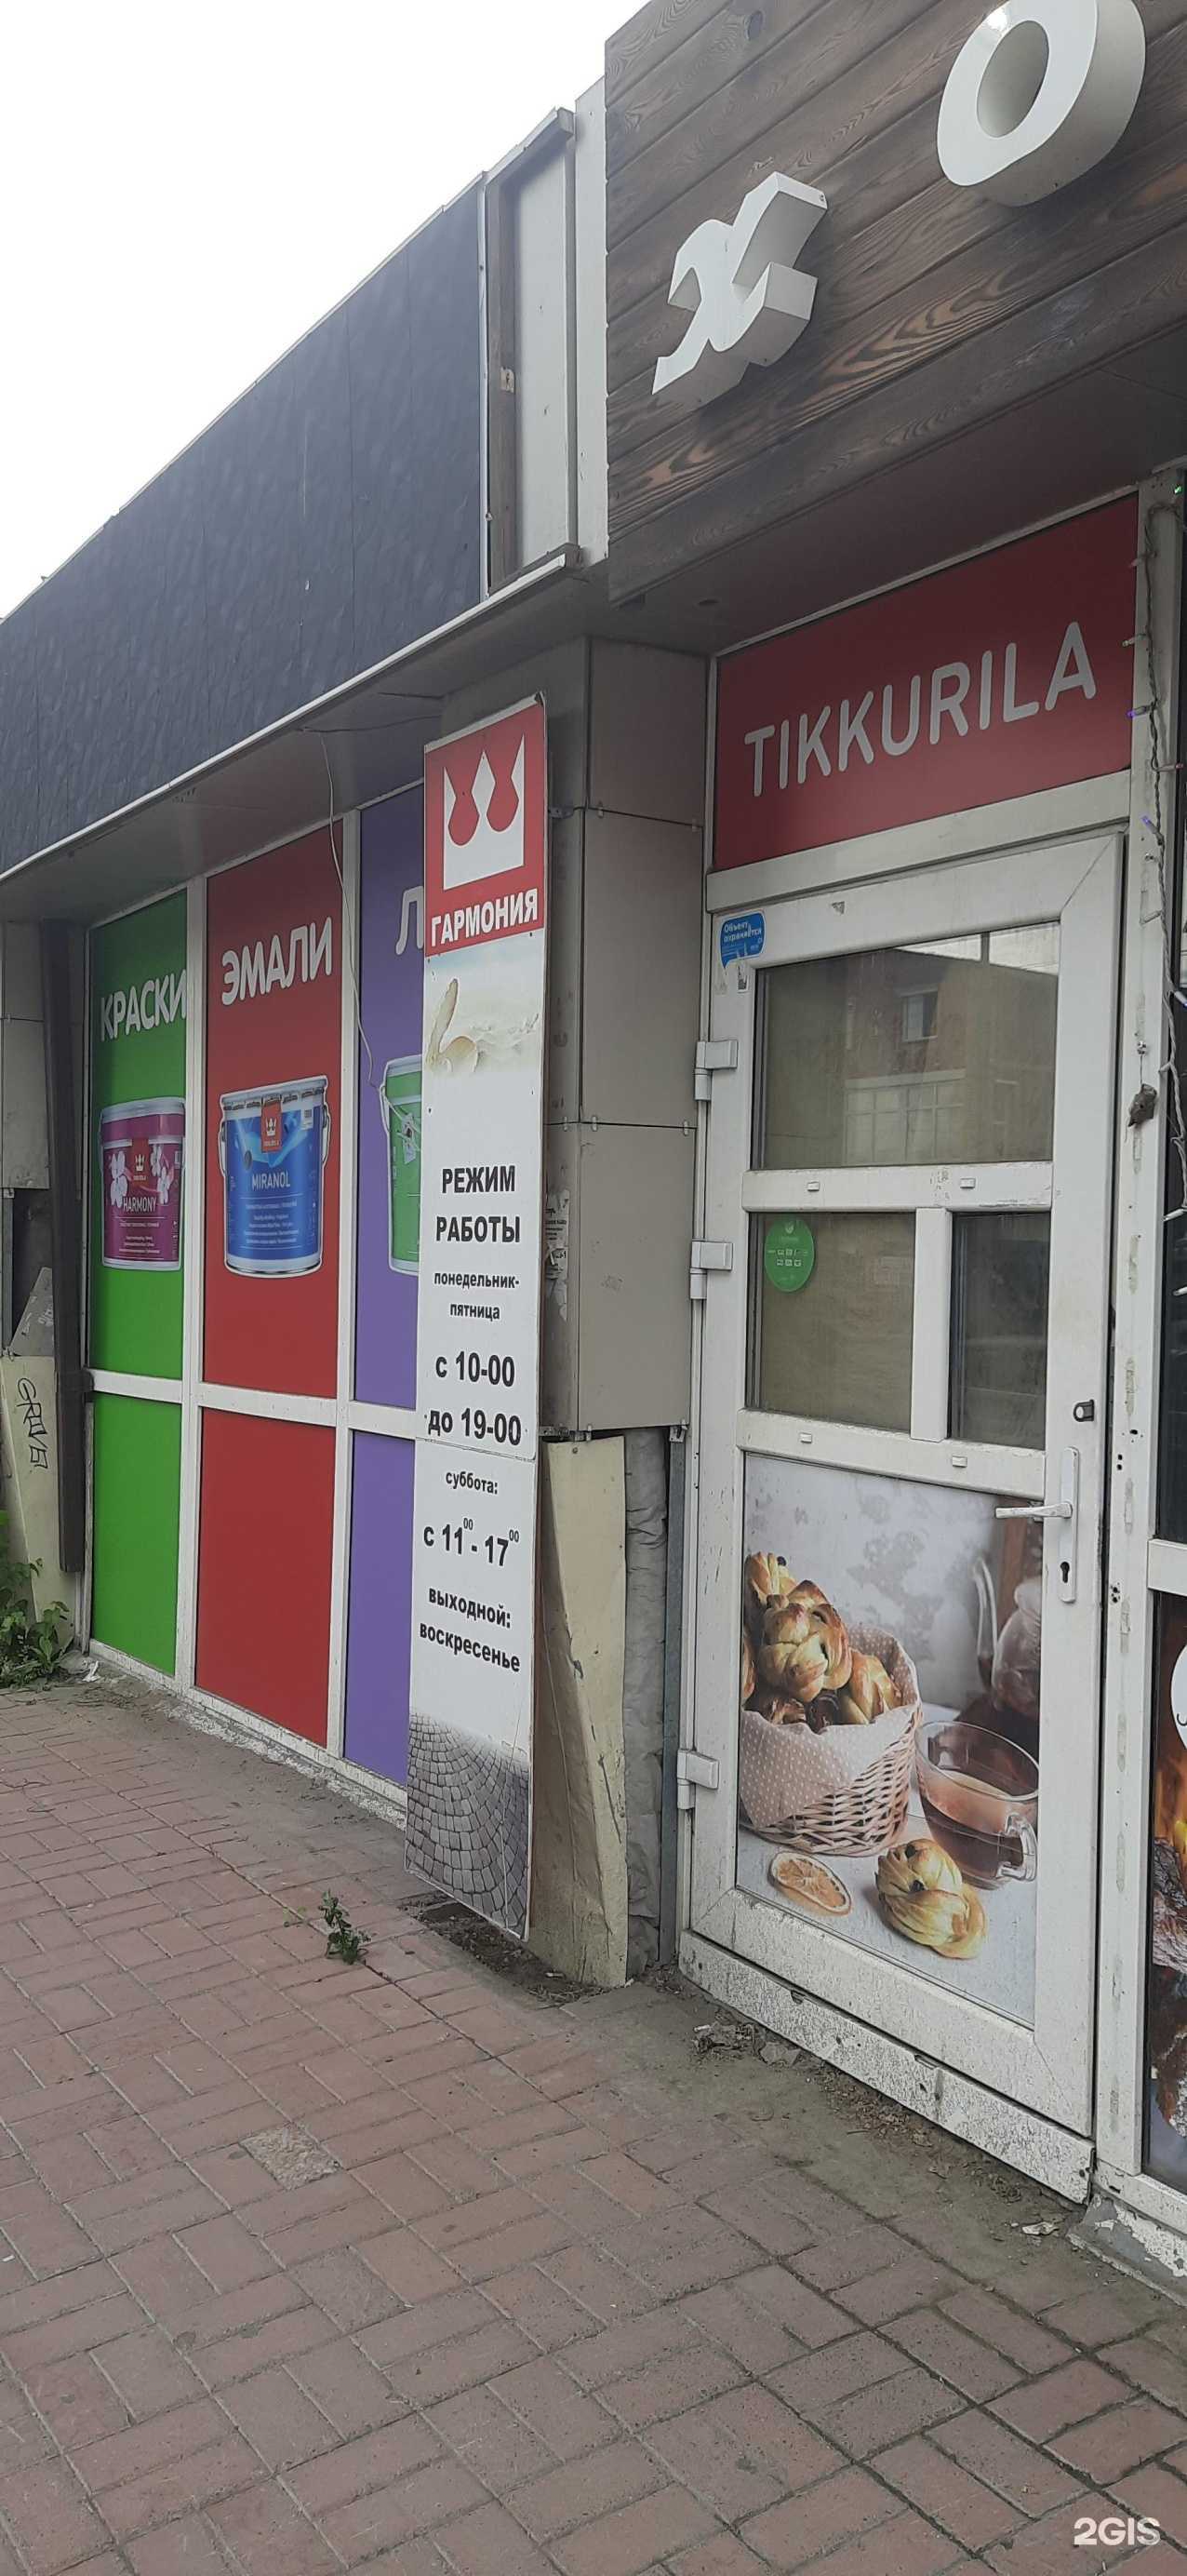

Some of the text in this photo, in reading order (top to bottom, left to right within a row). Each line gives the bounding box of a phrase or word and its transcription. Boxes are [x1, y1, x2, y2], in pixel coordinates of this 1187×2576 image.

[745, 622, 1096, 797] TIKKURILA
[431, 888, 538, 947] ГАРМОНИЯ
[221, 917, 332, 1006] ЭМАЛИ
[101, 969, 186, 1041] КРАСКИ
[252, 1171, 290, 1190] MIRANOL
[442, 1165, 515, 1194] РЕЖИМ
[123, 1197, 157, 1212] HARMONY
[436, 1216, 520, 1243] РАБОТЫ
[434, 1272, 519, 1289] понедельник-
[450, 1303, 500, 1322] пятница
[456, 1351, 515, 1387] 10-00
[428, 1407, 521, 1446] до 19-00
[447, 1471, 498, 1495] суббота:
[429, 1588, 511, 1629] выходной:
[420, 1622, 521, 1673] воскресенье
